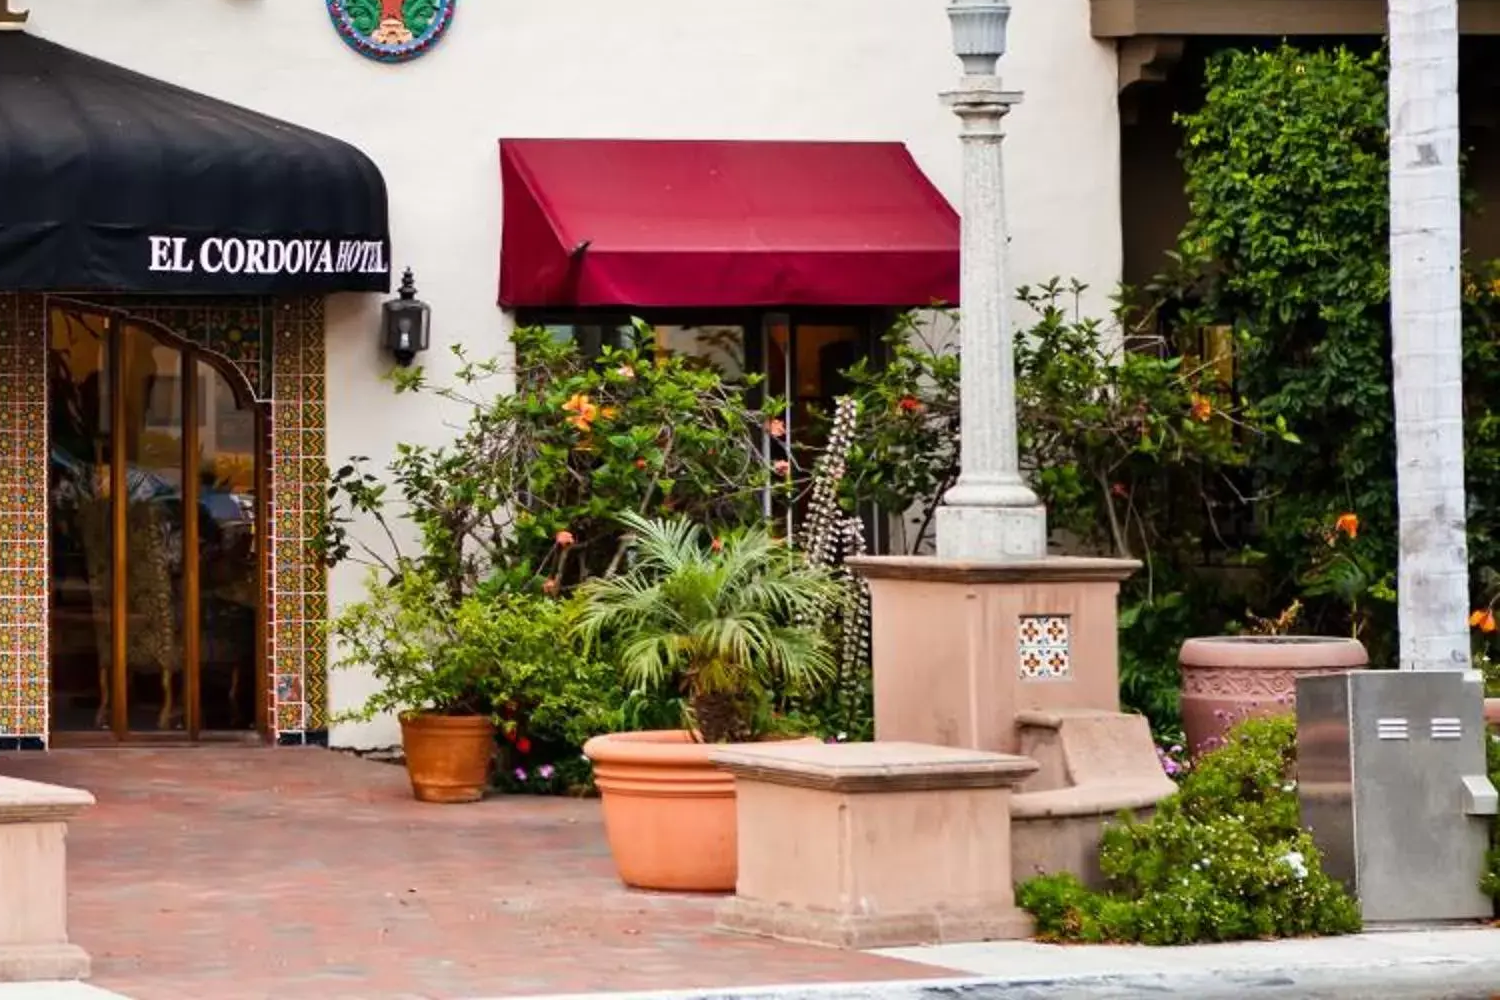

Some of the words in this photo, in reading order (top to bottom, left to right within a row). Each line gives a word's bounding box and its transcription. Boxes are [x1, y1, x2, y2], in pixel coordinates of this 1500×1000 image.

[148, 236, 194, 272] EL
[200, 237, 335, 274] CORDOVA
[334, 240, 389, 273] HOTEL
